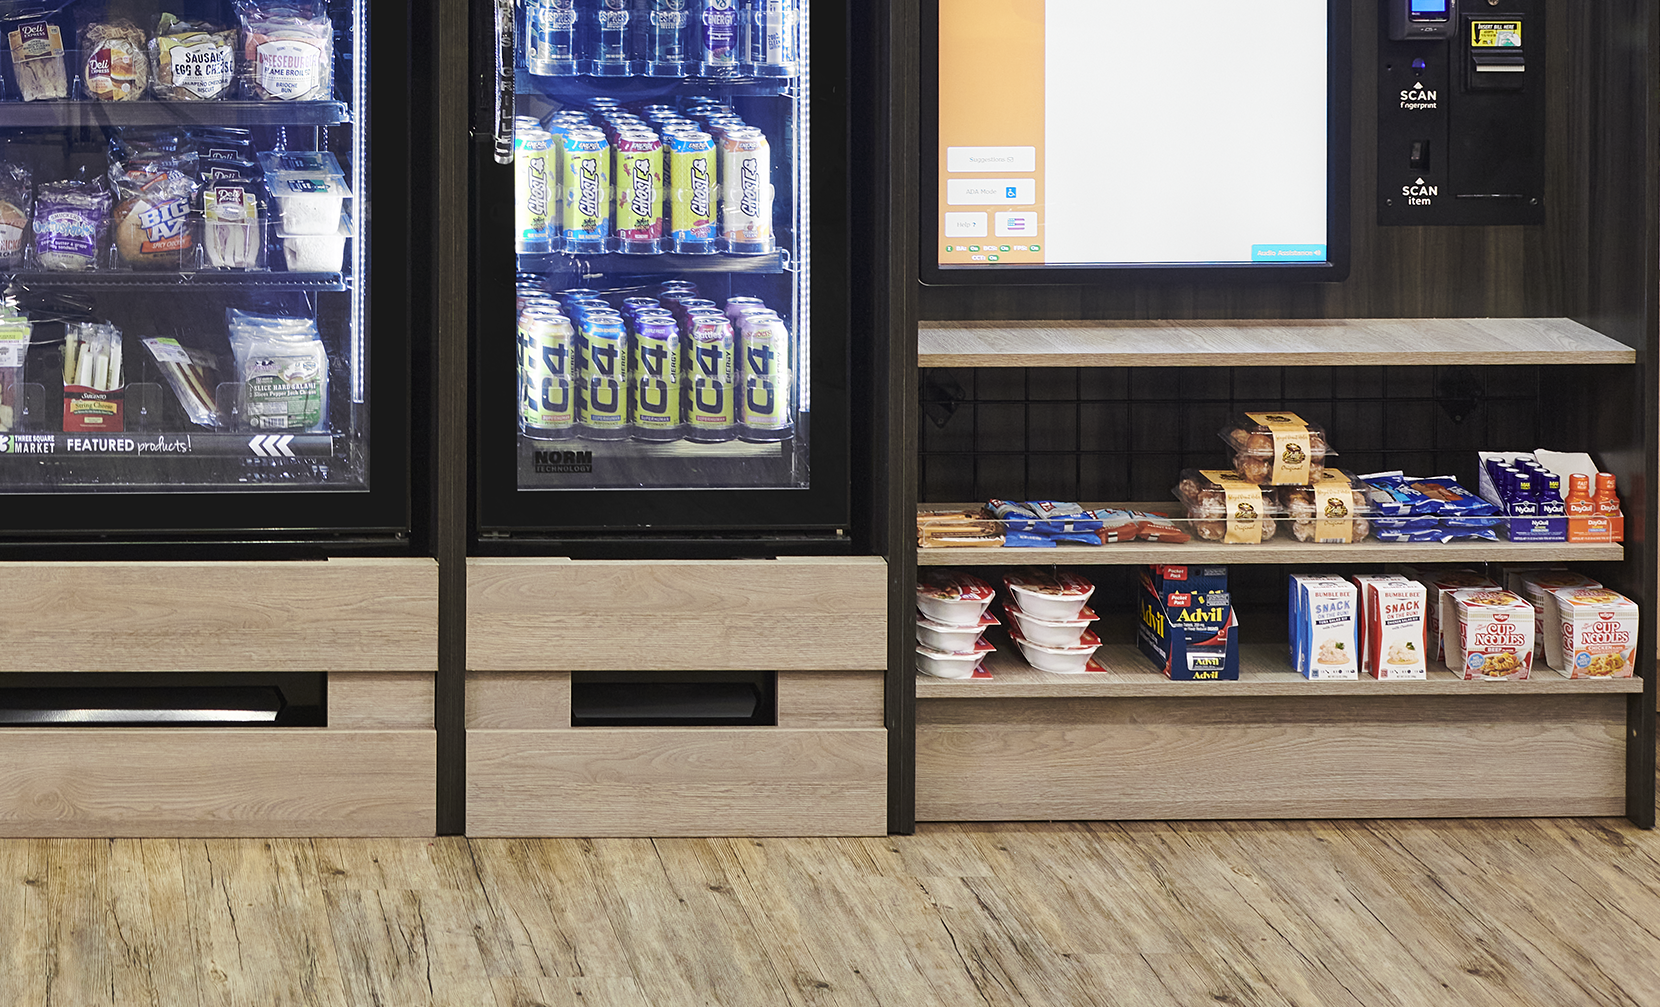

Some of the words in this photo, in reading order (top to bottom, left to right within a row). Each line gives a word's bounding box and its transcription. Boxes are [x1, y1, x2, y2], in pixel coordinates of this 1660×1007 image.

[708, 15, 733, 25] ENERGY
[90, 59, 109, 70] Deli
[195, 65, 203, 76] &
[1400, 90, 1437, 101] SCAN
[528, 169, 548, 217] GHOST
[578, 169, 600, 217] GHOST
[631, 169, 653, 218] GHOST
[1402, 185, 1438, 196] SCAN
[1408, 196, 1431, 205] item
[140, 197, 191, 229] BIG
[146, 219, 183, 242] AZ
[14, 443, 55, 453] MARKET
[67, 439, 134, 451] FEATURED
[137, 435, 192, 454] products!
[535, 451, 592, 464] NORM
[1515, 505, 1535, 513] NyQuil
[1543, 505, 1563, 513] NyQuil
[1570, 505, 1592, 513] DayQuil
[1315, 601, 1351, 613] SNACK
[1385, 601, 1420, 614] SNACK
[1176, 607, 1223, 622] Advil
[1486, 623, 1516, 635] CUP
[1592, 621, 1621, 634] CUP
[1474, 631, 1526, 646] NOODLES
[1581, 630, 1630, 645] NOODLES
[1196, 657, 1219, 665] Advil
[1192, 671, 1219, 679] Advil
